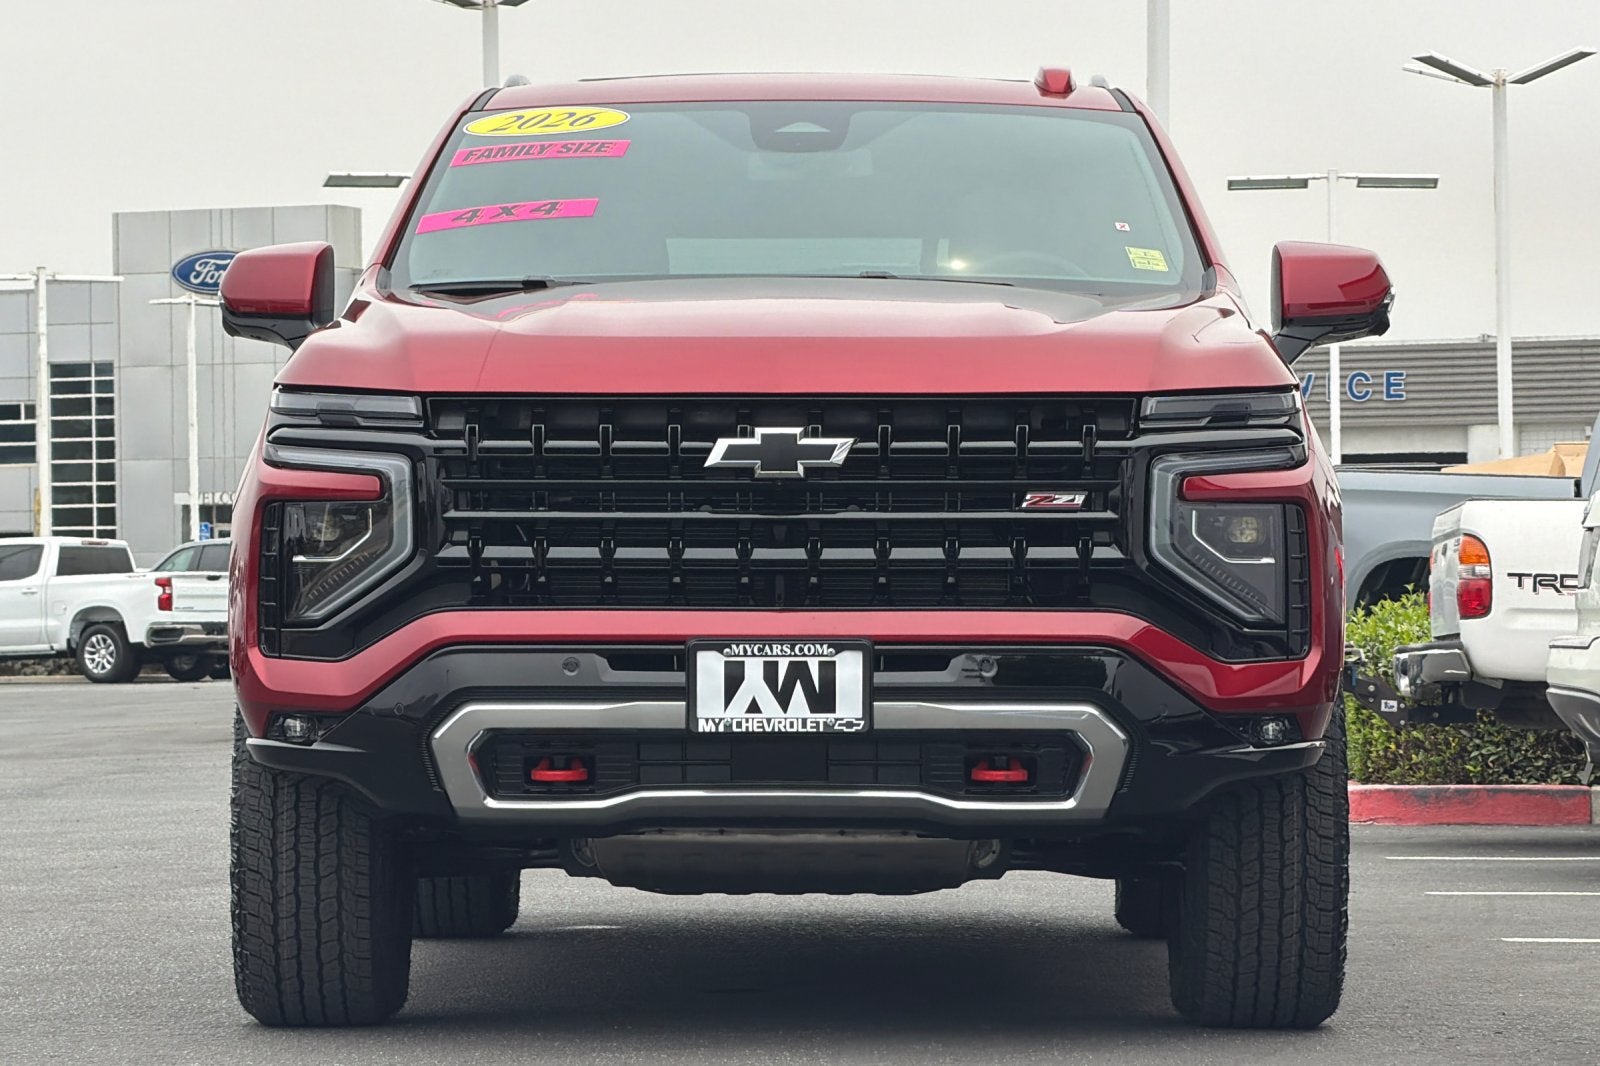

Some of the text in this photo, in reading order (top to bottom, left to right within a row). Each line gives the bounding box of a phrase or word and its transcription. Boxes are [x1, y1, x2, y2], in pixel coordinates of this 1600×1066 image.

[488, 111, 602, 132] 2026
[463, 141, 615, 163] FAMILY SIZE
[1021, 491, 1087, 509] Z71
[730, 644, 828, 656] MYCARS.COM
[698, 718, 826, 732] MY CHEVROLET
